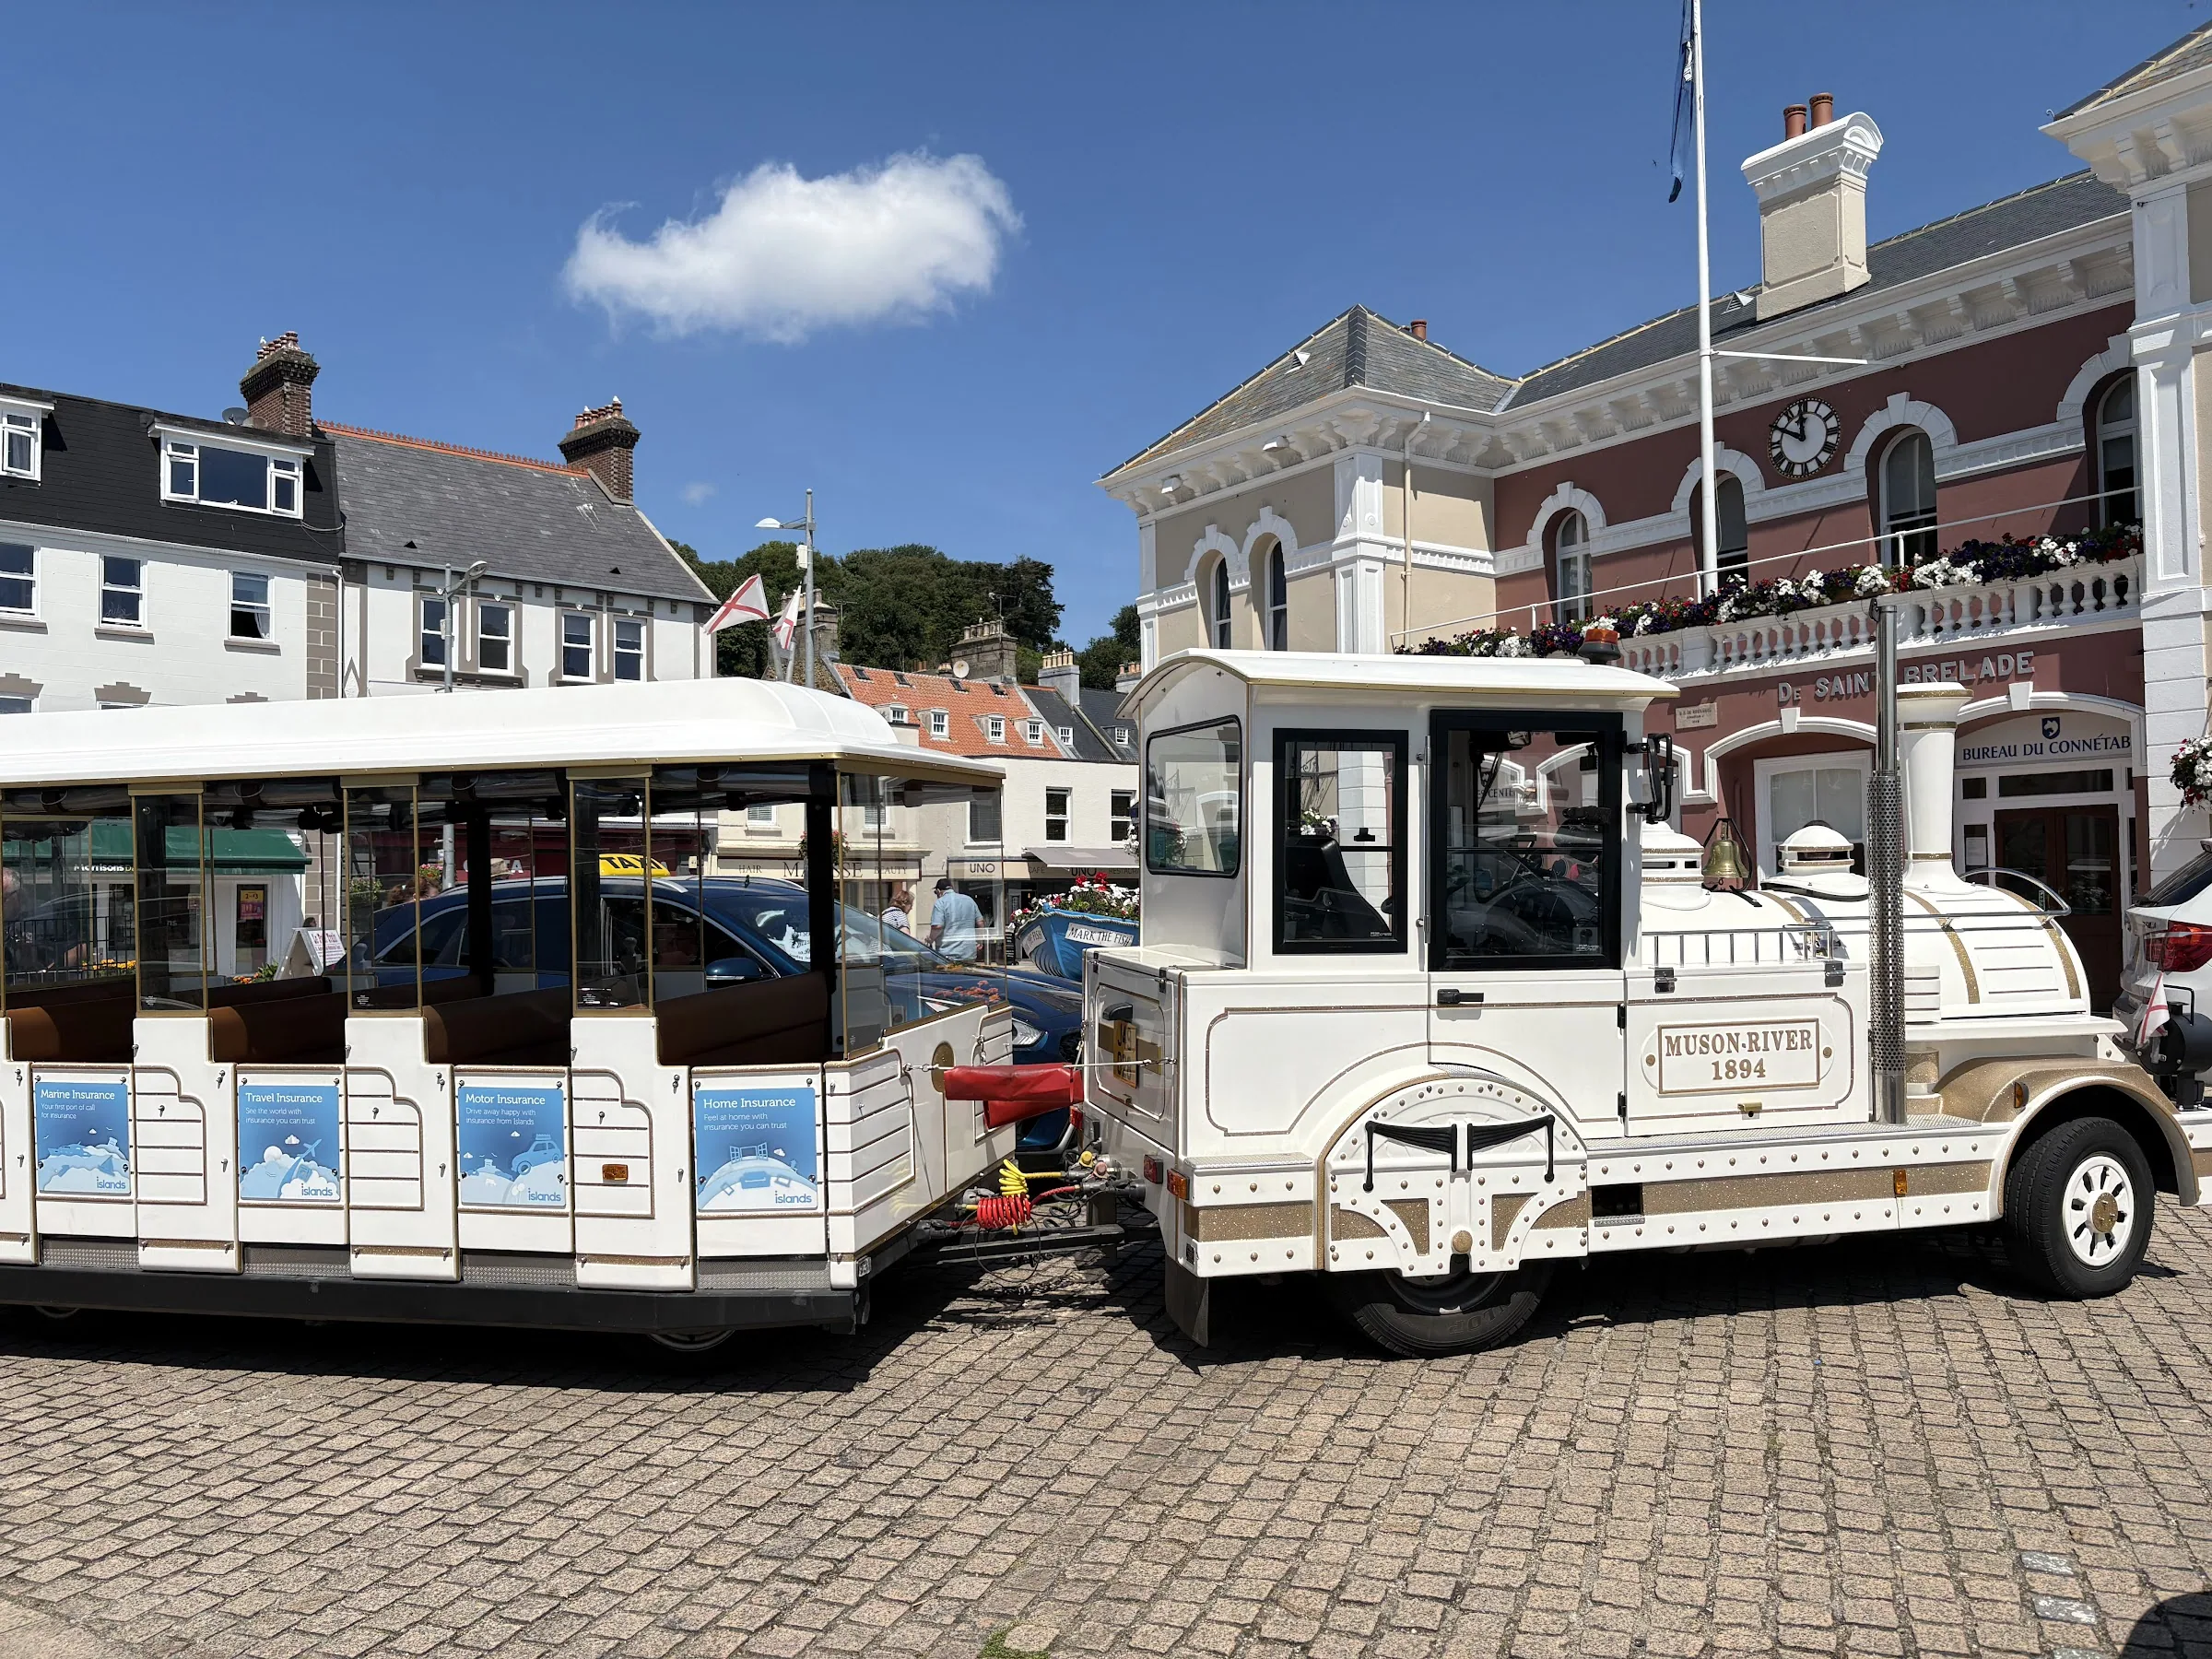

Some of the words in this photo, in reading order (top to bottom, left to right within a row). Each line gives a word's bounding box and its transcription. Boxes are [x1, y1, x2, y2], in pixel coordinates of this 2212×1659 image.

[1903, 651, 2035, 684] BRELADE
[1963, 745, 2017, 760] BUREAU
[2023, 742, 2043, 756] DU
[1488, 788, 1515, 798] CENTE
[738, 865, 762, 874] HAIR
[782, 861, 864, 878] MSSE
[970, 863, 995, 874] UNO
[1068, 926, 1094, 941] MARK
[1094, 931, 1112, 943] THE
[1114, 934, 1133, 947] FISH
[1712, 1058, 1766, 1080] 1894
[41, 1088, 70, 1099] Marine
[72, 1089, 115, 1100] Insurance
[245, 1092, 275, 1102] Travel
[276, 1092, 323, 1103] Insurance
[465, 1093, 495, 1103] Motor
[497, 1094, 546, 1105] Insurance
[65, 1103, 77, 1112] port
[703, 1099, 738, 1109] Home
[740, 1098, 795, 1108] Insurance
[269, 1107, 287, 1115] world
[465, 1107, 482, 1115] Drive
[483, 1109, 500, 1117] away
[500, 1108, 521, 1117] happy
[703, 1123, 738, 1131] insurance
[740, 1124, 755, 1132] you
[97, 1176, 125, 1189] islands
[301, 1182, 333, 1196] islands
[528, 1187, 561, 1202] islands
[775, 1190, 812, 1204] islands
